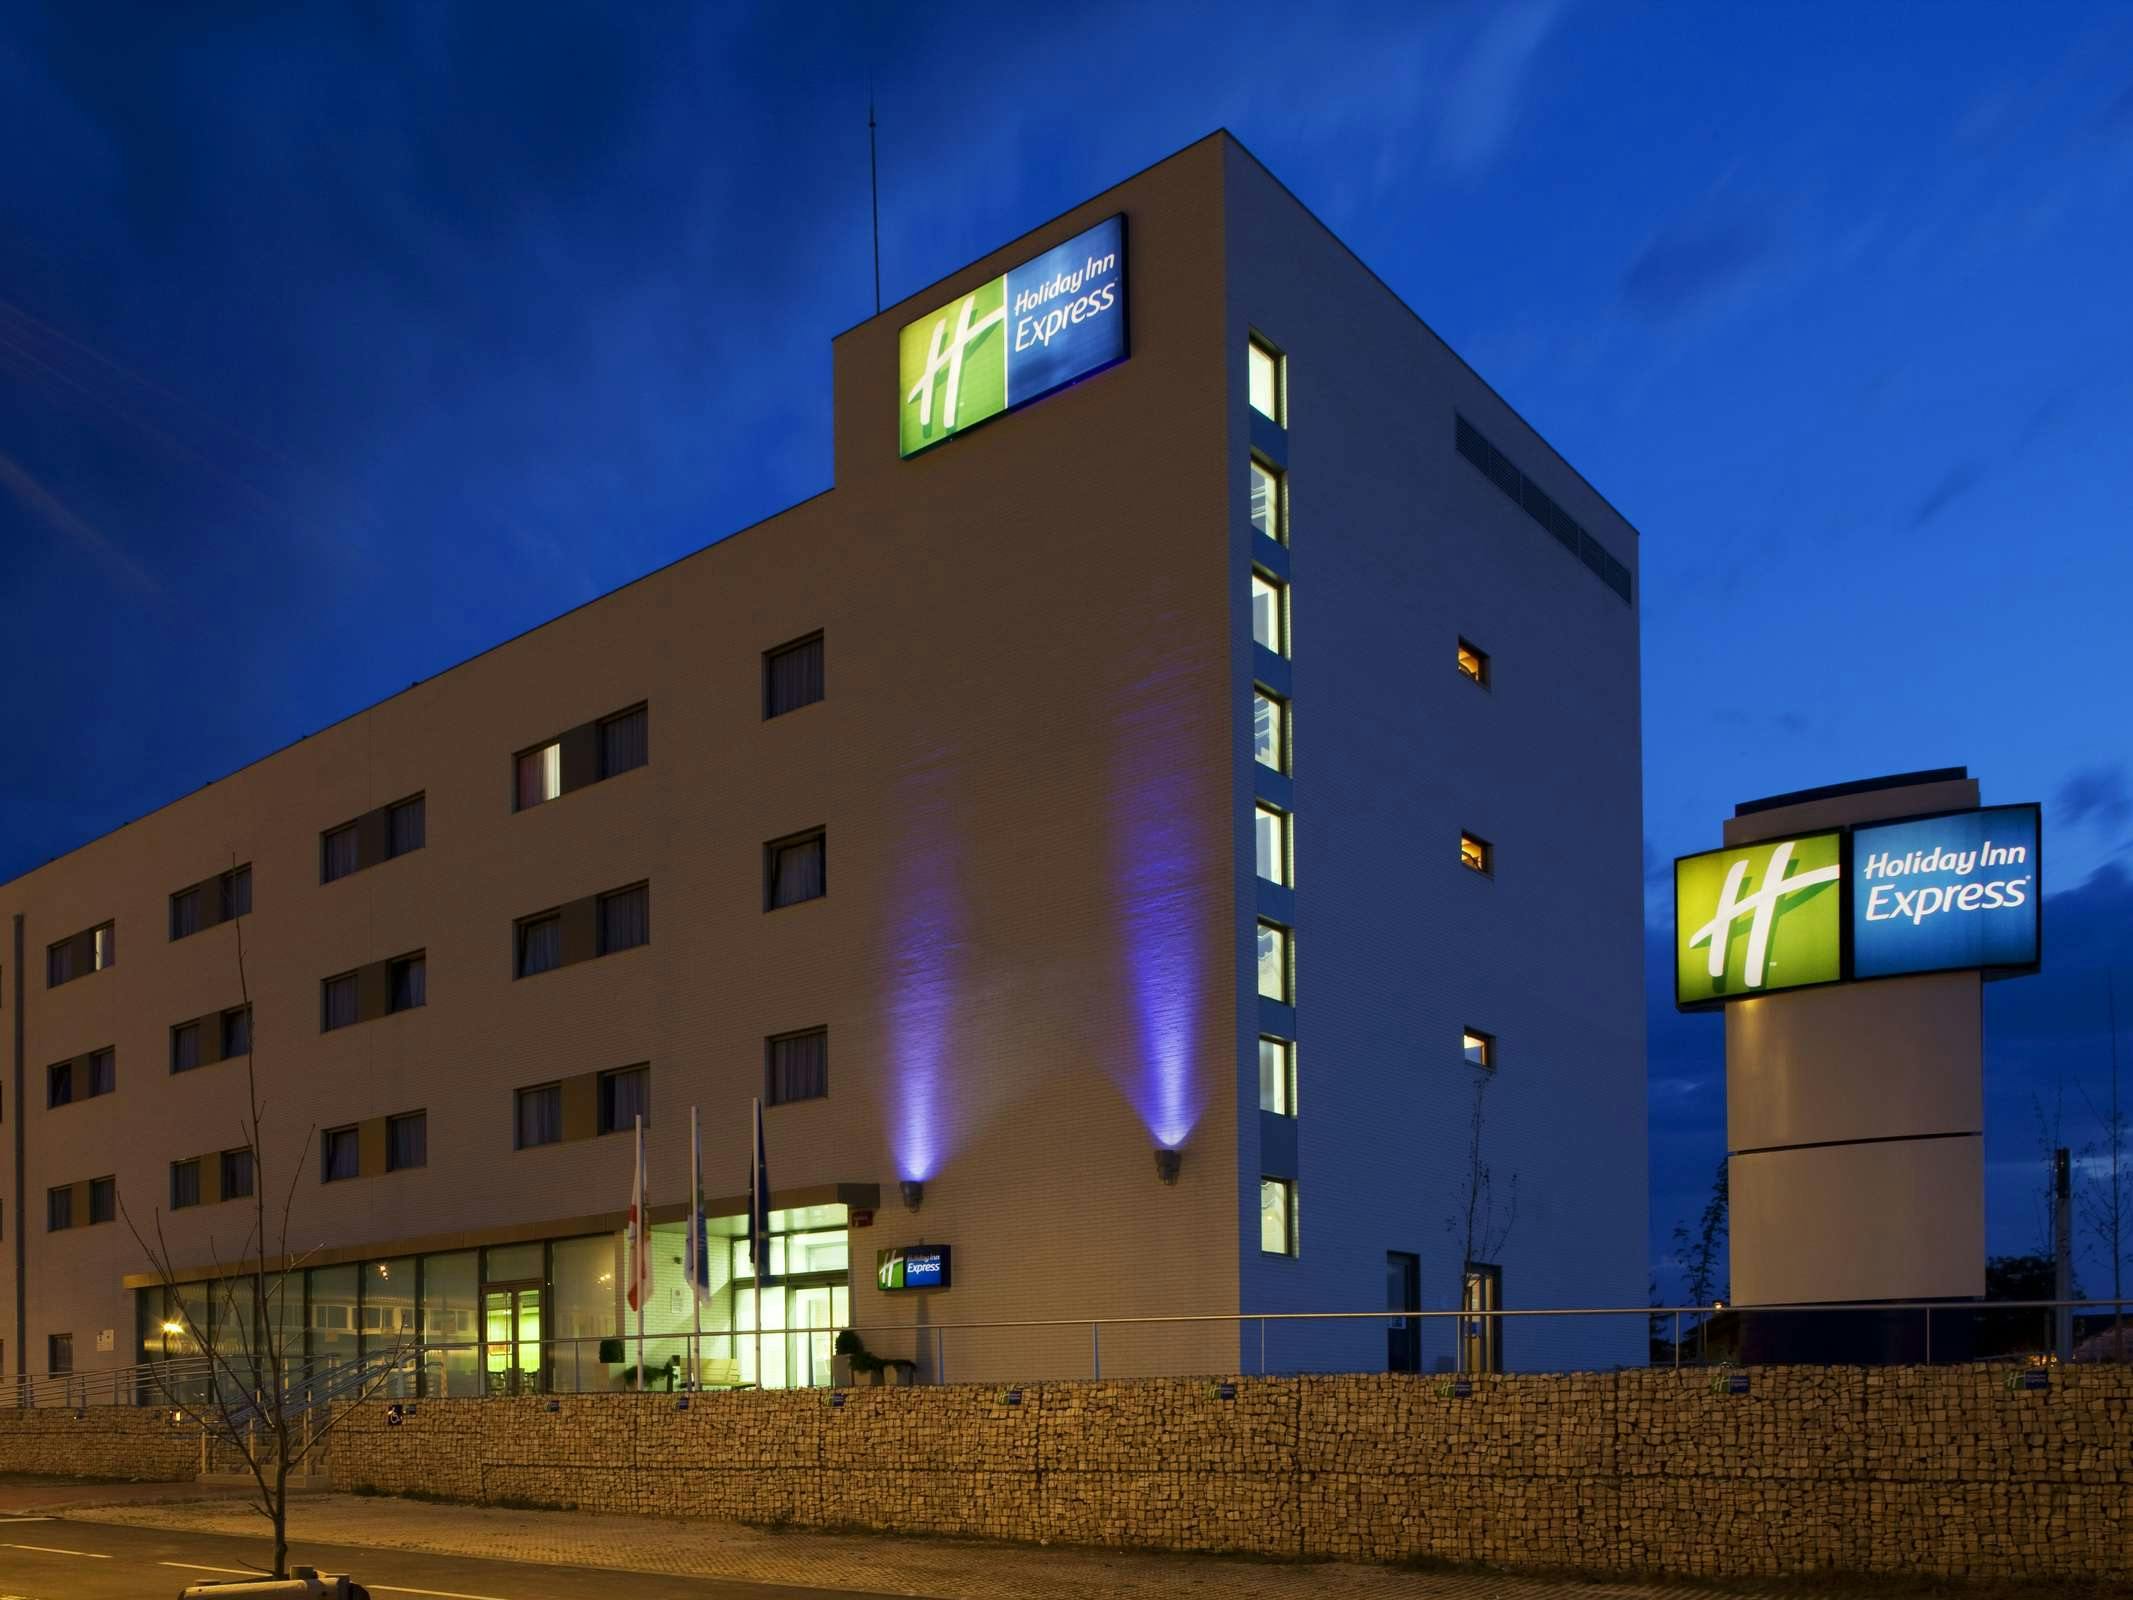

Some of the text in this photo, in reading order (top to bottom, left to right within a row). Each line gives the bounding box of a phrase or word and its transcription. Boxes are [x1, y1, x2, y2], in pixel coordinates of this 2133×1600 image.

[1014, 253, 1115, 317] Holiday Inn
[1015, 282, 1115, 353] Express
[907, 295, 1005, 429] H
[1863, 841, 2026, 879] Holiday Inn
[1689, 841, 1840, 988] H
[1865, 878, 2027, 926] Express
[907, 1262, 940, 1274] Express
